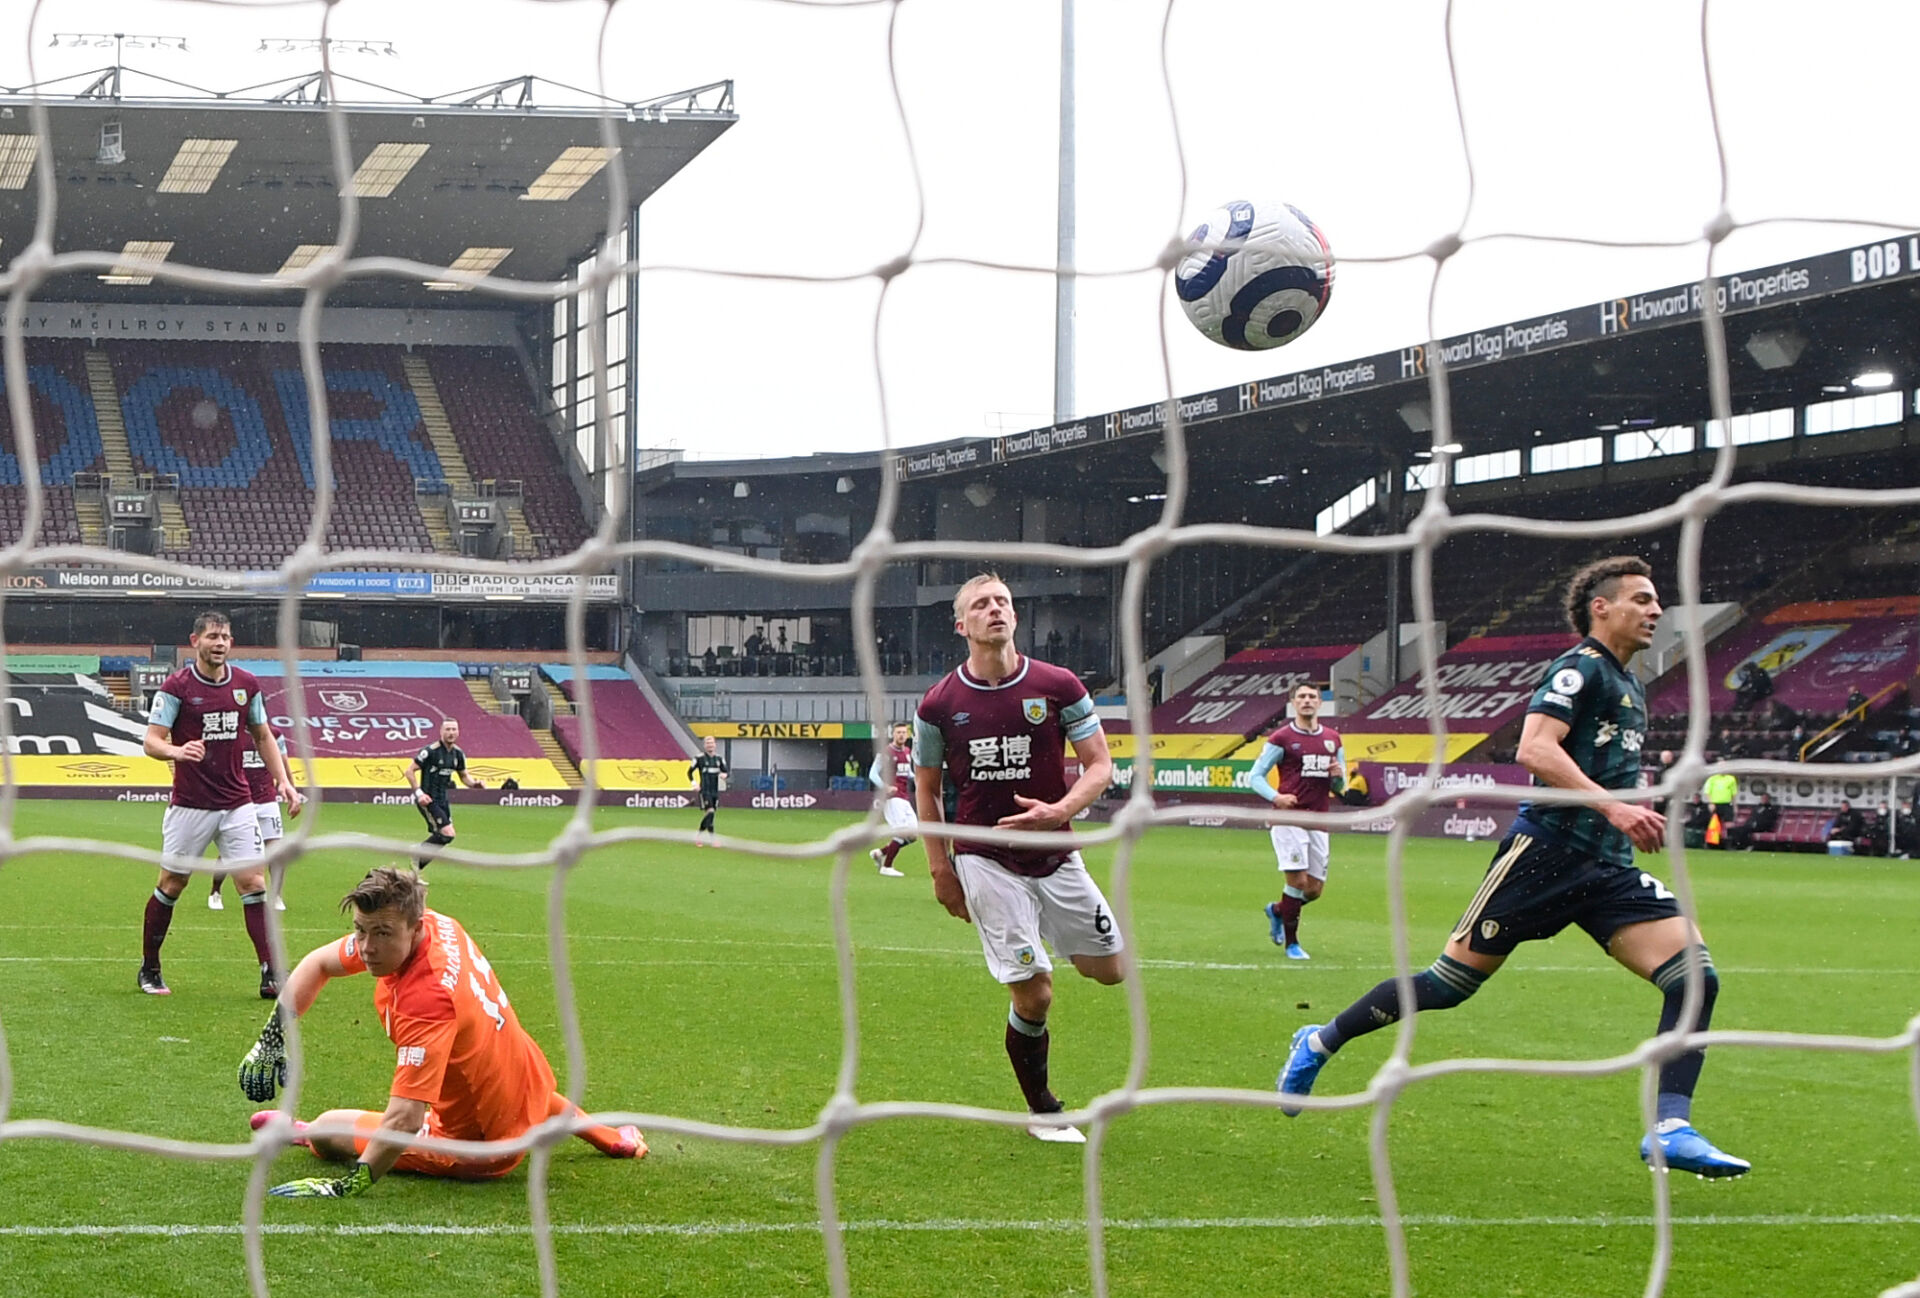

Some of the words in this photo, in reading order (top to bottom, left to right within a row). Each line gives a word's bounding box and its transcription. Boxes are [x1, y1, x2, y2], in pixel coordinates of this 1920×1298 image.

[1852, 242, 1900, 283] BOB
[1601, 299, 1629, 335] HR
[1631, 288, 1689, 322] Howard
[1693, 284, 1727, 314] Rig
[1731, 268, 1809, 304] Properties
[206, 321, 286, 333] STAND
[1401, 347, 1425, 379] HR
[1474, 333, 1502, 361] Rigg
[1505, 316, 1567, 353] Properties
[1239, 383, 1258, 411] HR
[1260, 376, 1298, 402] Howard
[1299, 373, 1322, 399] Rigg
[1324, 363, 1375, 392] Properties
[1105, 413, 1122, 439] HR
[1122, 406, 1153, 430] Howard
[1177, 396, 1218, 420] Properties
[991, 436, 1007, 462] HR
[1006, 430, 1032, 452] Howard
[1033, 427, 1049, 452] Rigg
[1051, 423, 1087, 449] Properties
[908, 451, 931, 473] Howard
[932, 449, 945, 472] Rigg
[946, 446, 977, 468] Properties
[117, 502, 124, 512] E
[462, 508, 469, 518] E
[59, 572, 108, 585] Nelson
[112, 573, 138, 585] and
[142, 573, 183, 586] Colne
[434, 574, 469, 585] BBC
[473, 576, 520, 585] RADIO
[139, 674, 147, 684] E
[1415, 661, 1527, 690] COME
[1191, 674, 1249, 697] WE
[1228, 672, 1311, 696] MISS
[1176, 700, 1246, 724] YOU
[1366, 690, 1535, 720] BURNLEY
[271, 716, 342, 729] ONE
[348, 717, 434, 729] CLUB
[737, 723, 822, 737] STANLEY
[202, 731, 238, 740] LoveBet
[319, 729, 368, 744] for
[385, 726, 428, 741] all
[968, 735, 1032, 768] 爱博
[970, 767, 1032, 781] LoveBet
[1112, 763, 1185, 787] bet5.com
[1186, 764, 1252, 788] bet365.co
[1472, 774, 1496, 789] Club
[117, 790, 167, 802] clarets
[373, 792, 417, 805] claret
[500, 793, 548, 807] clarets
[626, 794, 678, 808] clarets
[752, 793, 805, 808] clarets
[1095, 904, 1112, 934] 6
